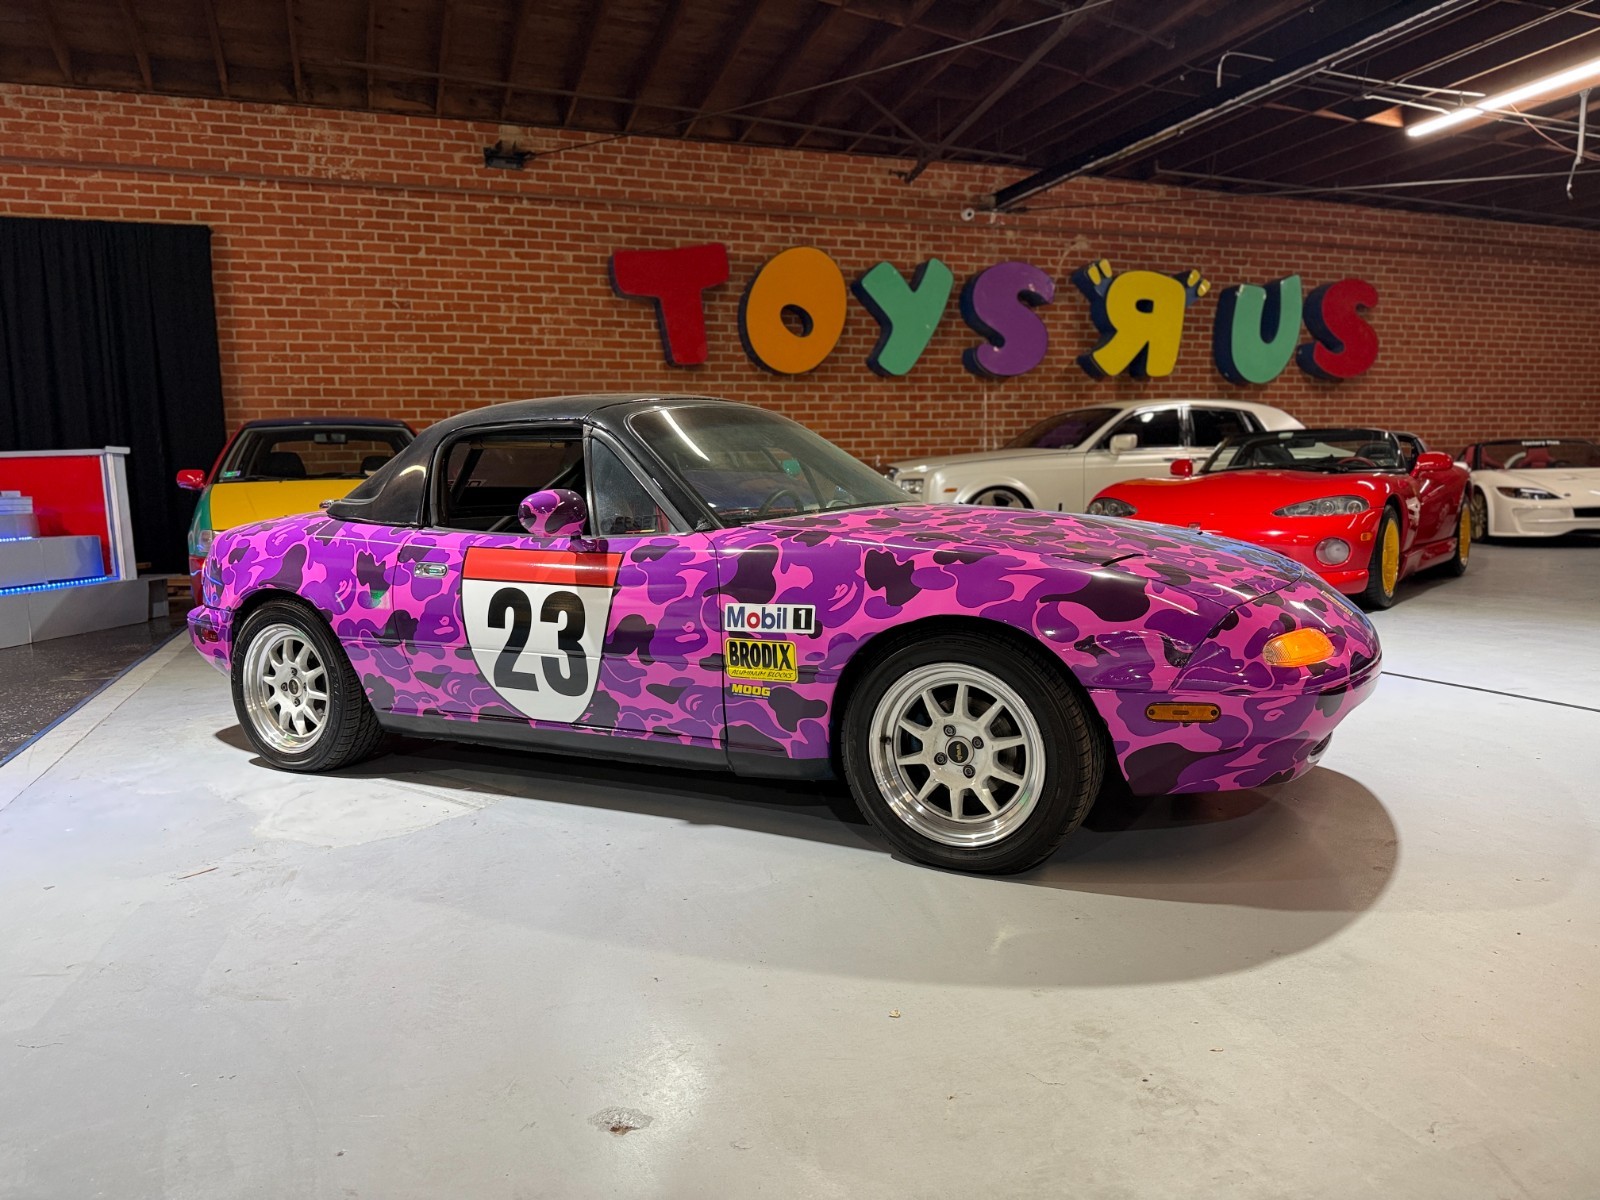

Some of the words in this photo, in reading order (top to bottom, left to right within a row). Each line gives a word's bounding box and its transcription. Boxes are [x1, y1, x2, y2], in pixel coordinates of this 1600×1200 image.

[608, 243, 1055, 377] TOYS
[1212, 274, 1379, 384] US
[727, 606, 787, 629] Mobil
[798, 609, 807, 629] 1
[487, 587, 588, 696] 23
[729, 641, 792, 671] BRODIX
[731, 669, 767, 677] ALUMINUM
[767, 671, 794, 679] BLOCKS
[731, 683, 771, 697] MOOG
